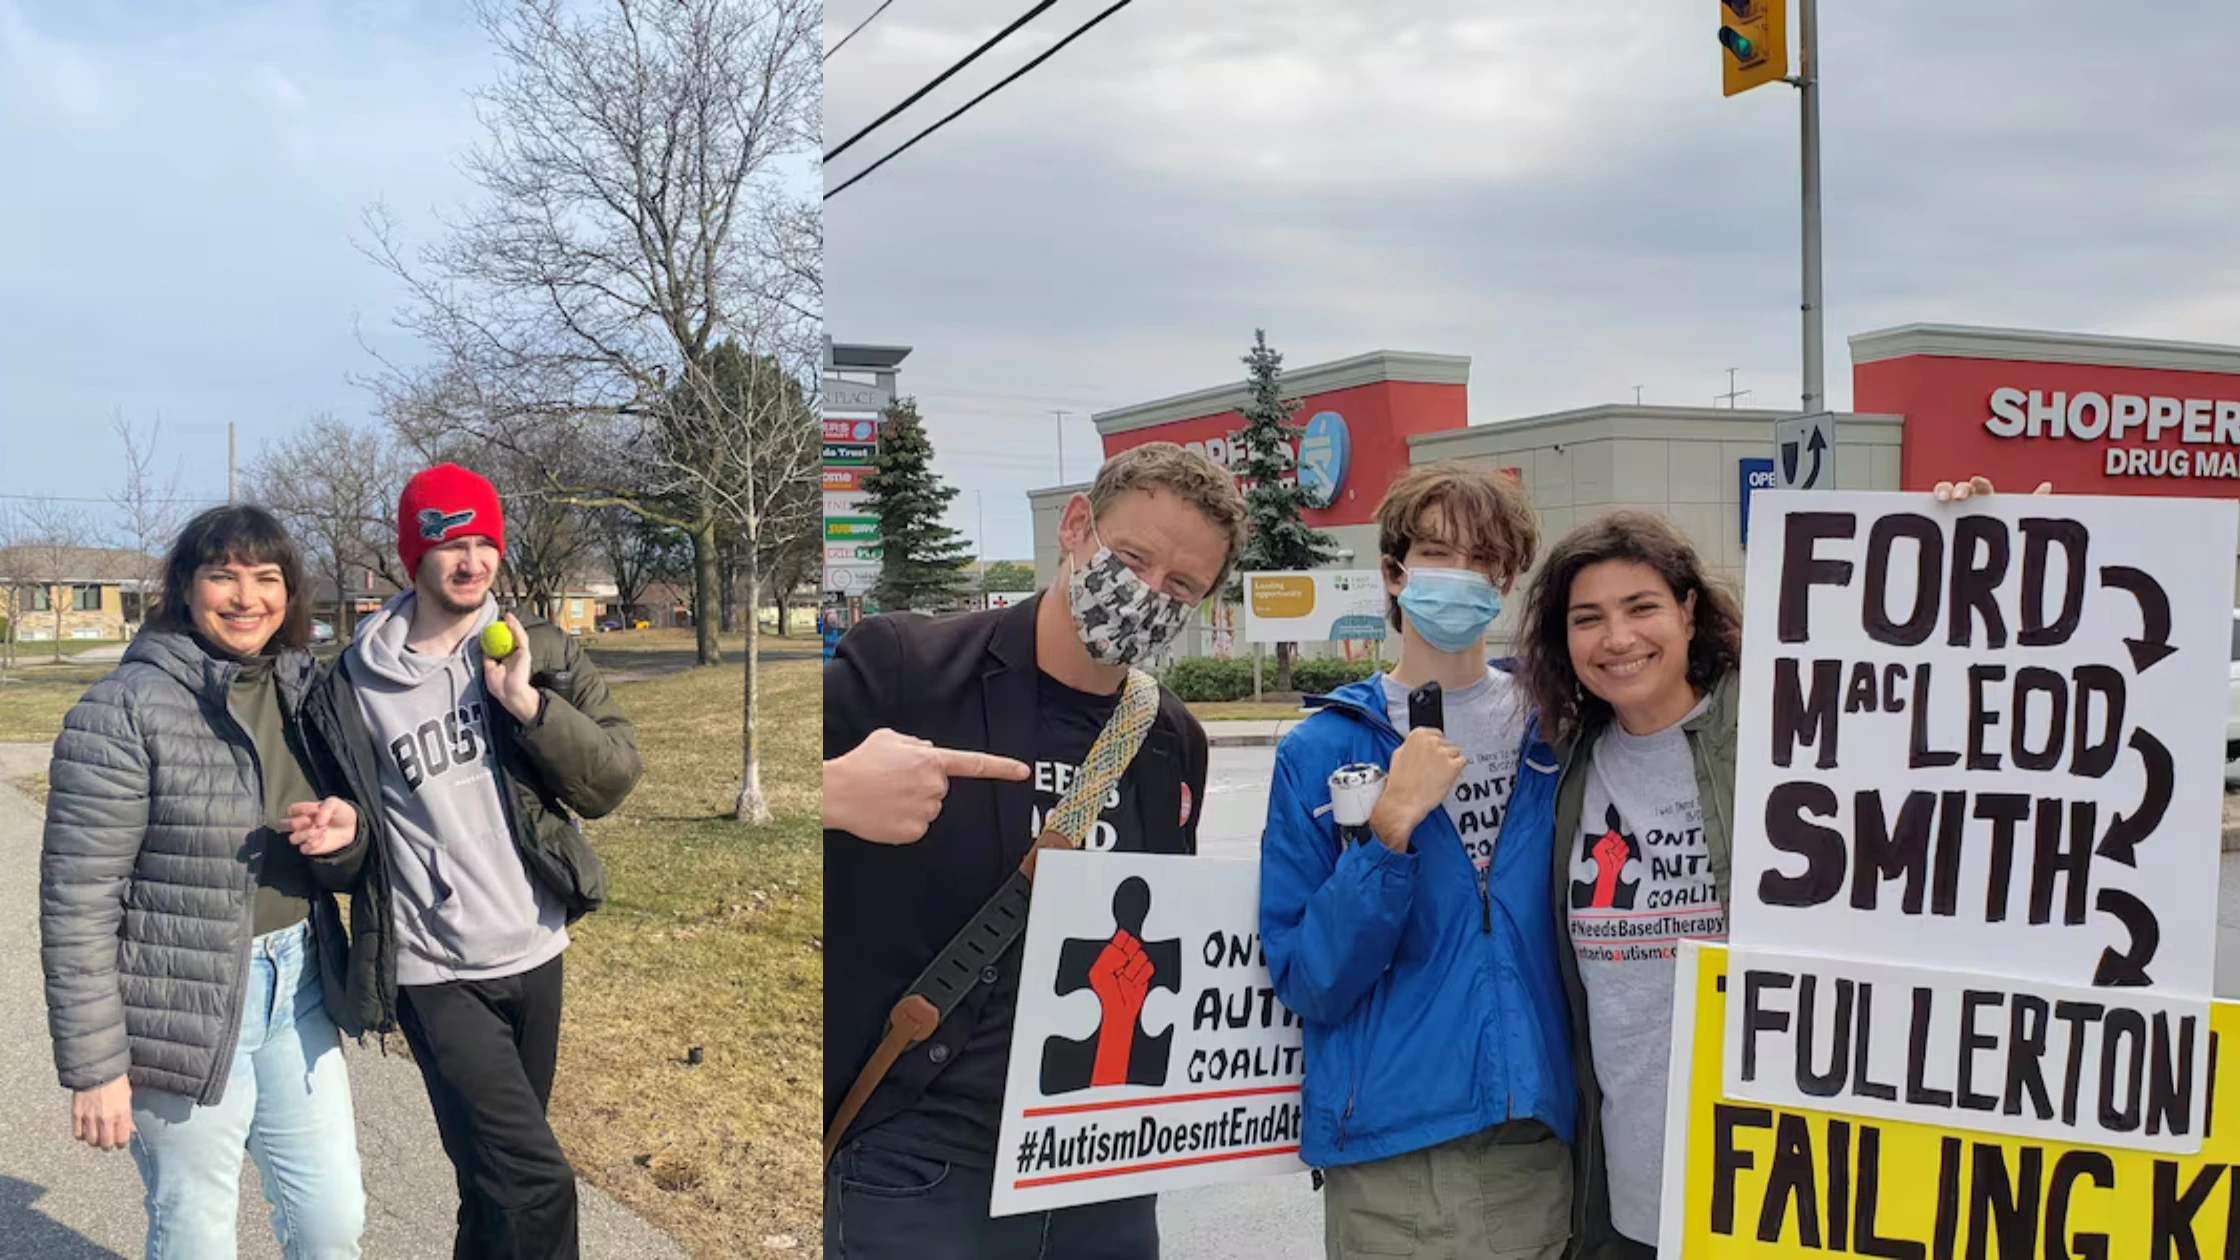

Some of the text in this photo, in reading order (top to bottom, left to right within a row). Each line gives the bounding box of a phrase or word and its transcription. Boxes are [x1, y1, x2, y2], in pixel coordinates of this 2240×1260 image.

[835, 391, 876, 405] PLACE
[1985, 387, 2240, 443] SHOPPER
[2106, 448, 2240, 478] DRUG MA
[1777, 512, 2089, 649] FORD
[1459, 805, 1507, 835] AU
[1465, 839, 1498, 859] CO
[1758, 780, 2097, 926] SMITH
[1741, 970, 2197, 1136] FULLERTON
[1016, 1103, 1301, 1174] #AutismDoesntEndAt
[1710, 1103, 2115, 1260] FAILING
